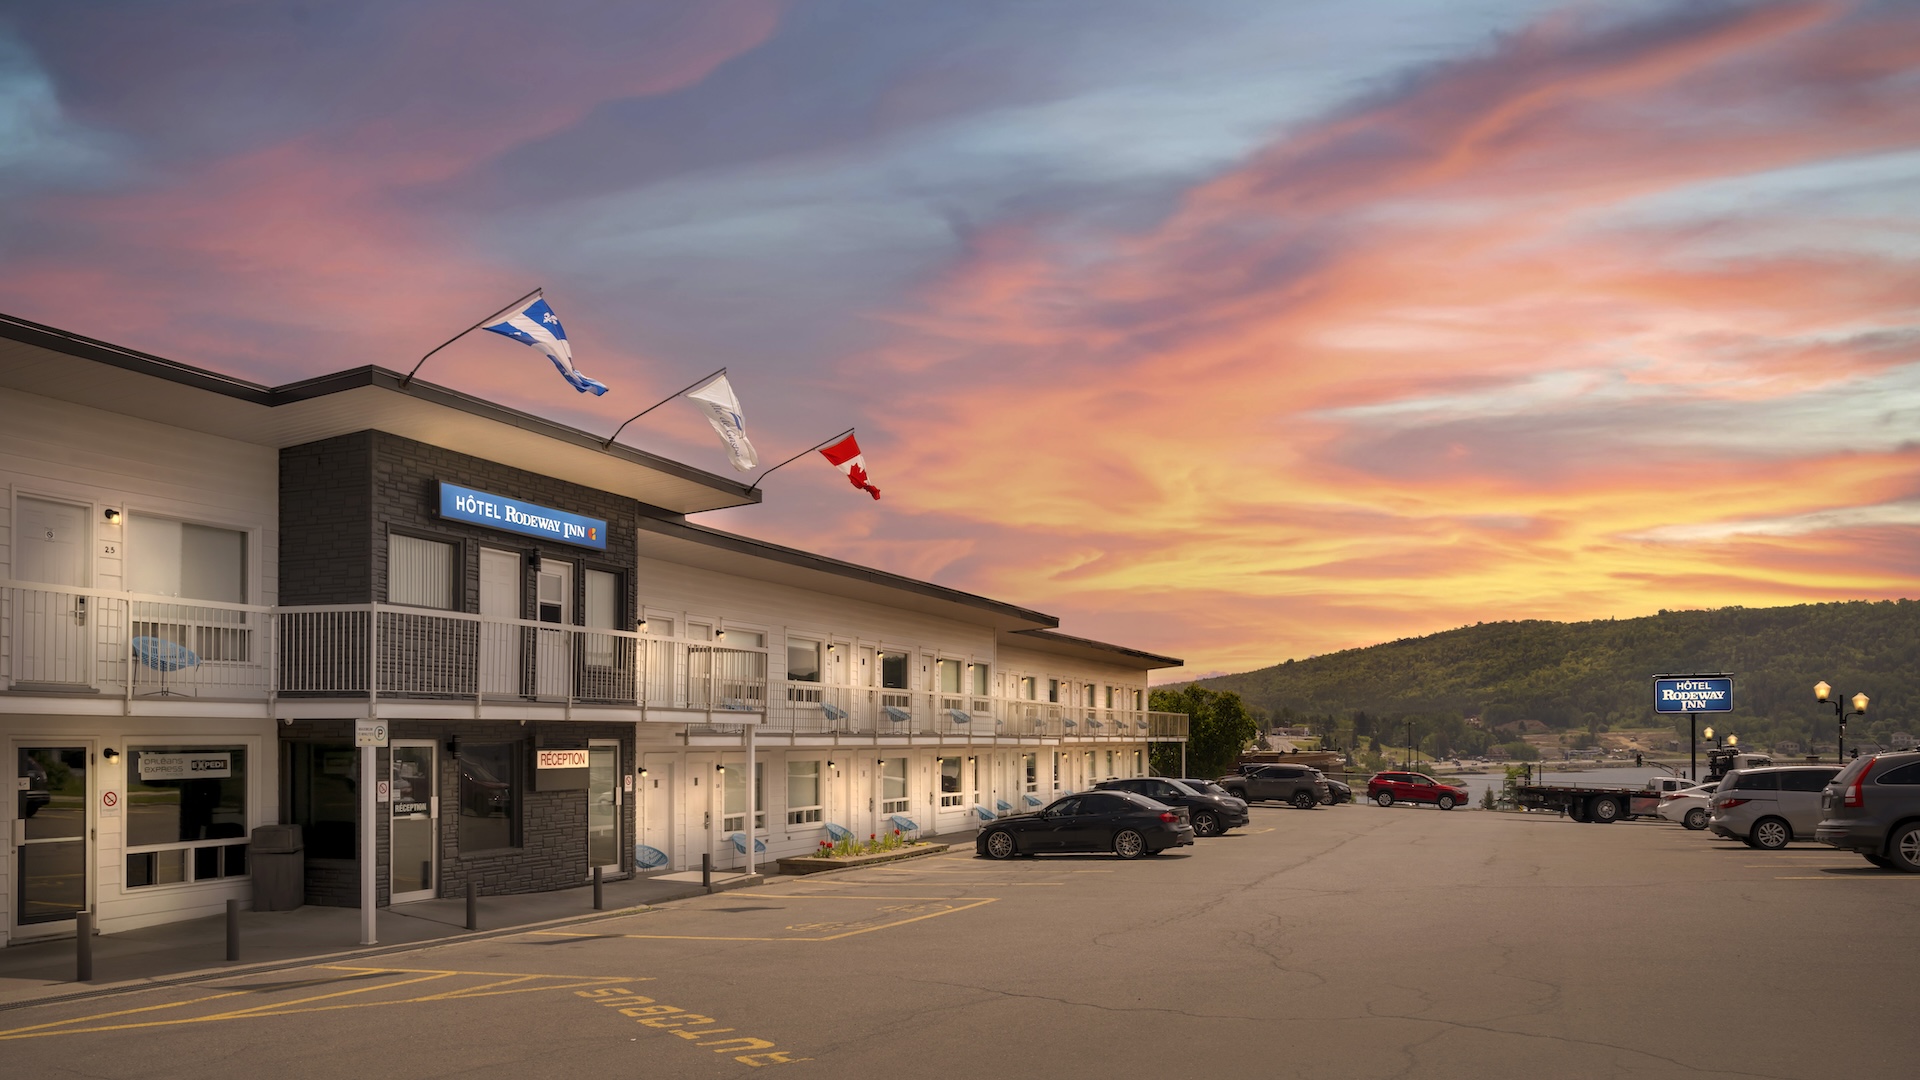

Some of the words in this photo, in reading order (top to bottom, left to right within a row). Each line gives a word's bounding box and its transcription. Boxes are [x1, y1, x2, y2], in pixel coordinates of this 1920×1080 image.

[456, 494, 501, 519] HÔTEL
[563, 522, 585, 539] INN
[105, 546, 115, 554] 25
[1676, 680, 1712, 690] HÔTEL
[1681, 700, 1707, 711] INN
[541, 751, 585, 765] RÉCEPTION
[395, 803, 427, 812] RÉCEPTION
